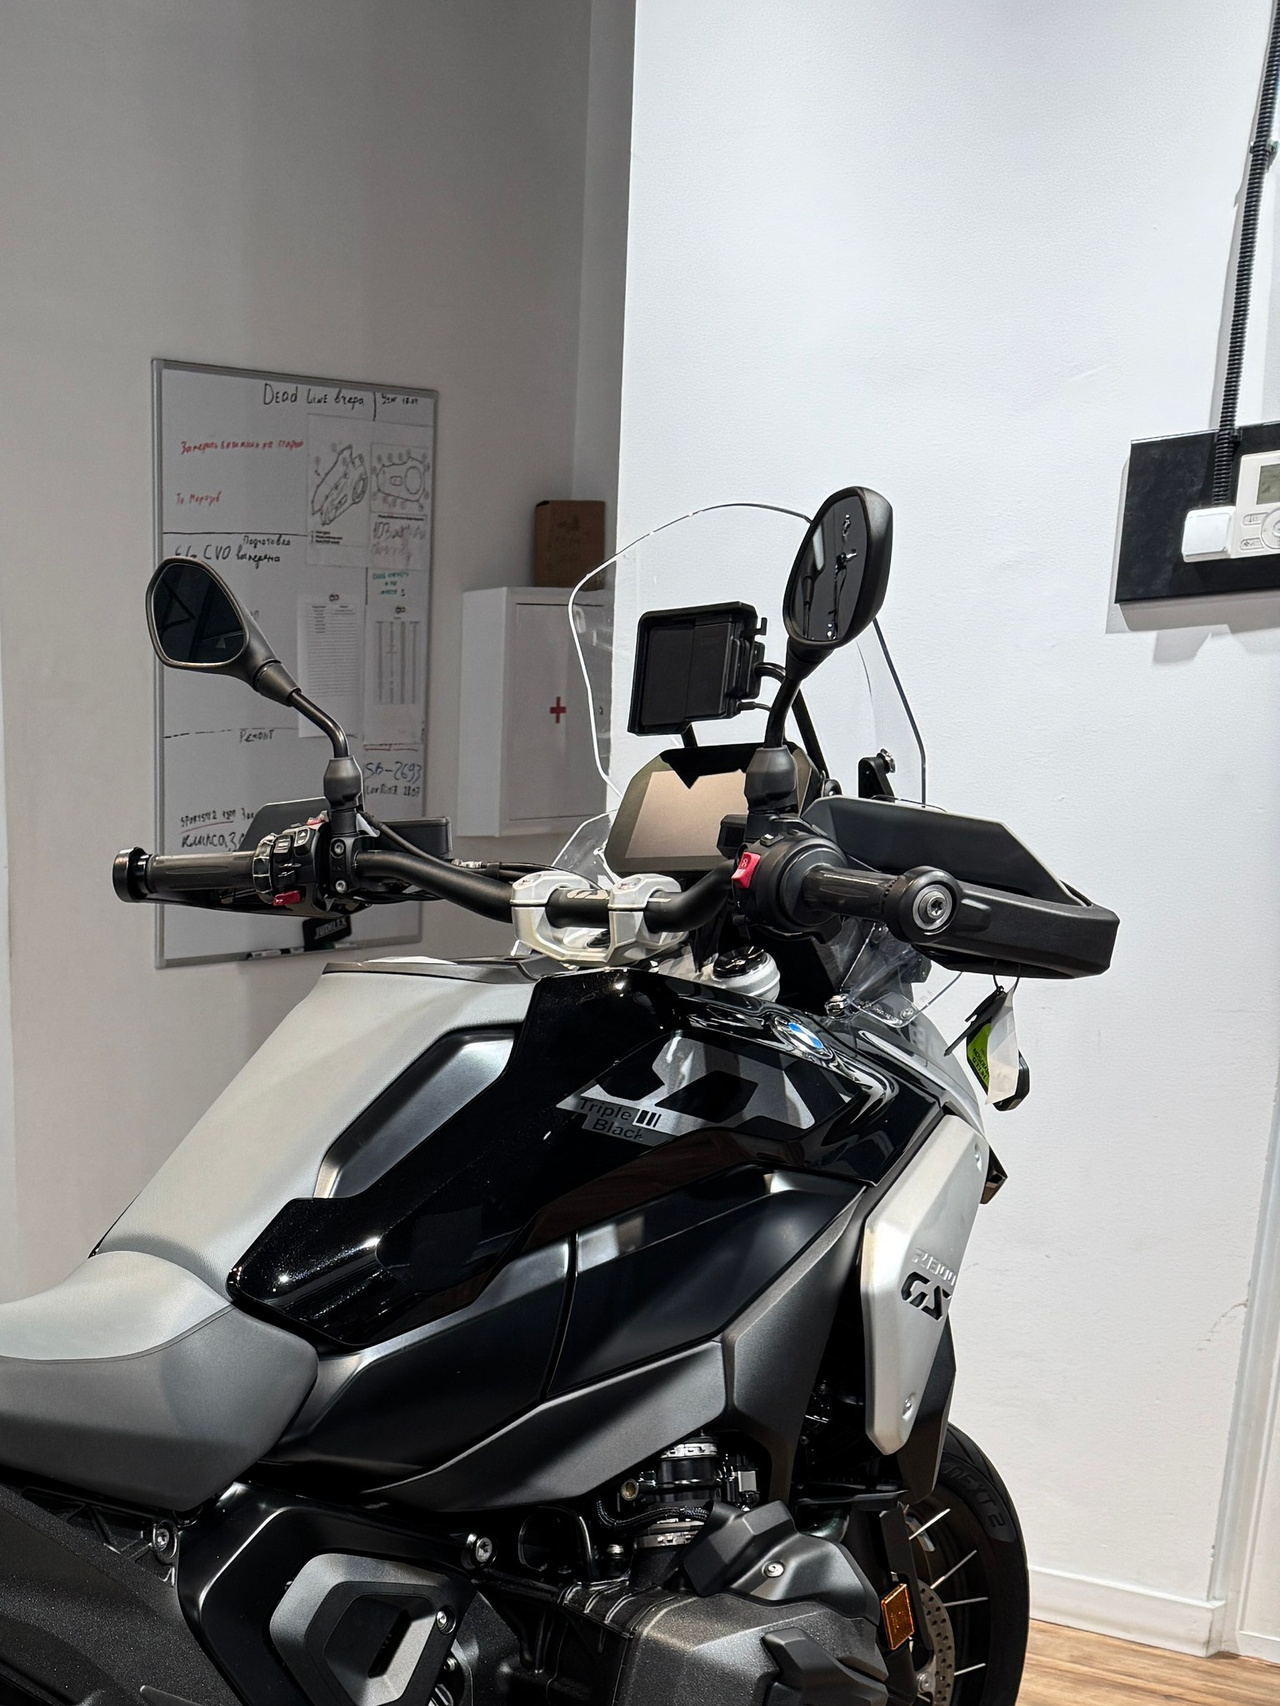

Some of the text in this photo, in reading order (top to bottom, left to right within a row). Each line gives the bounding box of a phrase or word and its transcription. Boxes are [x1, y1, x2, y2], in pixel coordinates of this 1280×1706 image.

[580, 1098, 632, 1121] Triple
[592, 1118, 644, 1141] Black
[900, 1271, 952, 1321] GS
